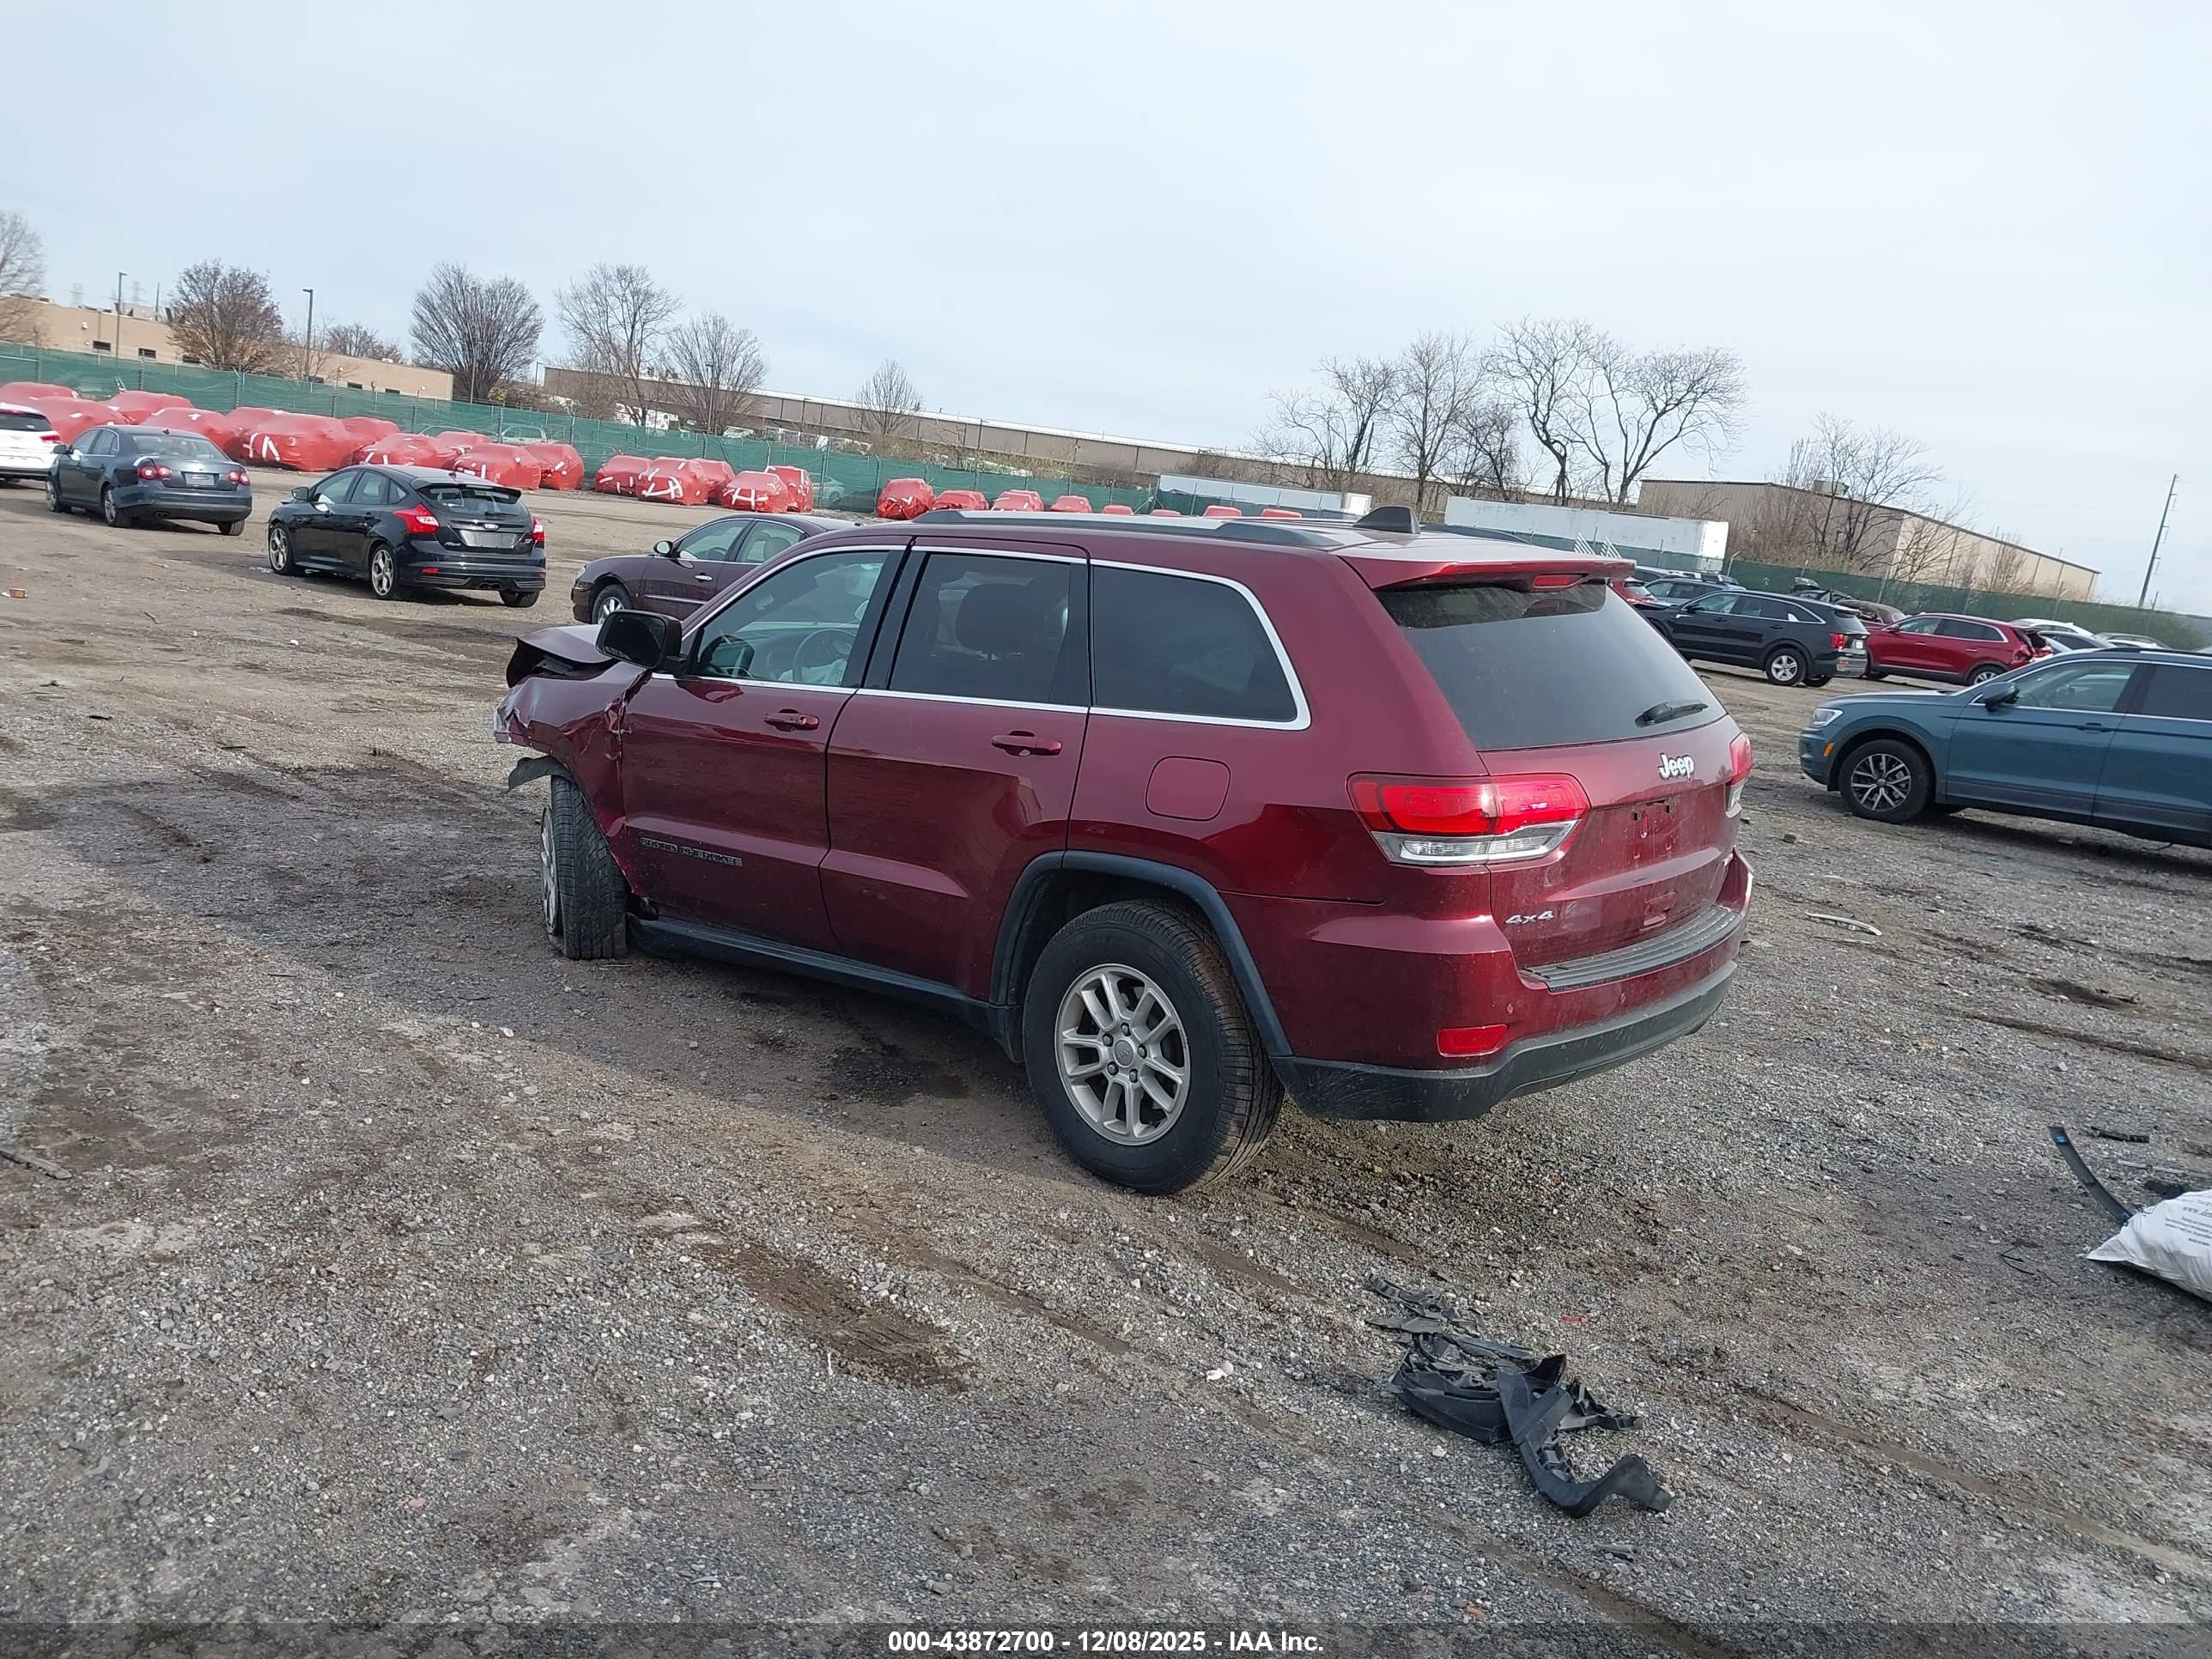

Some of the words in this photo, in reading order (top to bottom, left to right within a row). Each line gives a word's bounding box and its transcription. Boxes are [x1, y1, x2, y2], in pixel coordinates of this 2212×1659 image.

[1657, 752, 1694, 780] Jeep
[680, 846, 743, 866] CHEROKEE
[1504, 910, 1554, 924] 4x4
